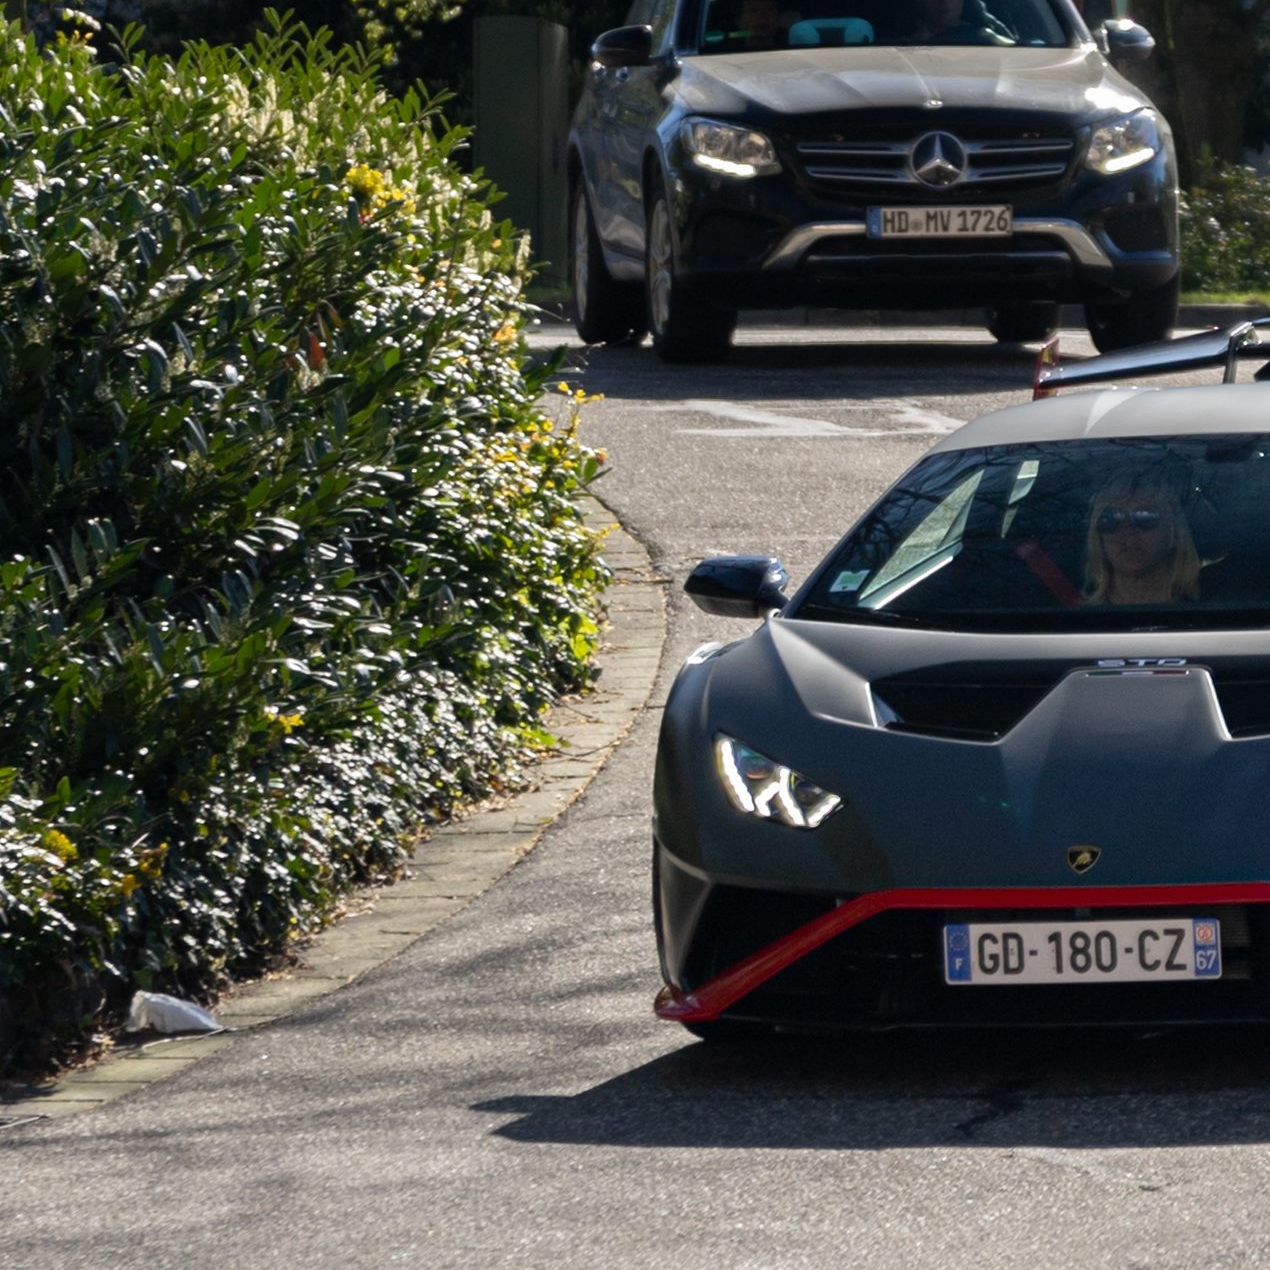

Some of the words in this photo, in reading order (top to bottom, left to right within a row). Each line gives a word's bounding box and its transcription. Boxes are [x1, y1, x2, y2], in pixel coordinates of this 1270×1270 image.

[883, 210, 909, 233] HD
[925, 210, 952, 232] MV
[957, 210, 1008, 232] 1726
[977, 928, 1188, 975] GD-180-CZ
[1196, 950, 1216, 970] 67
[954, 958, 963, 971] F
